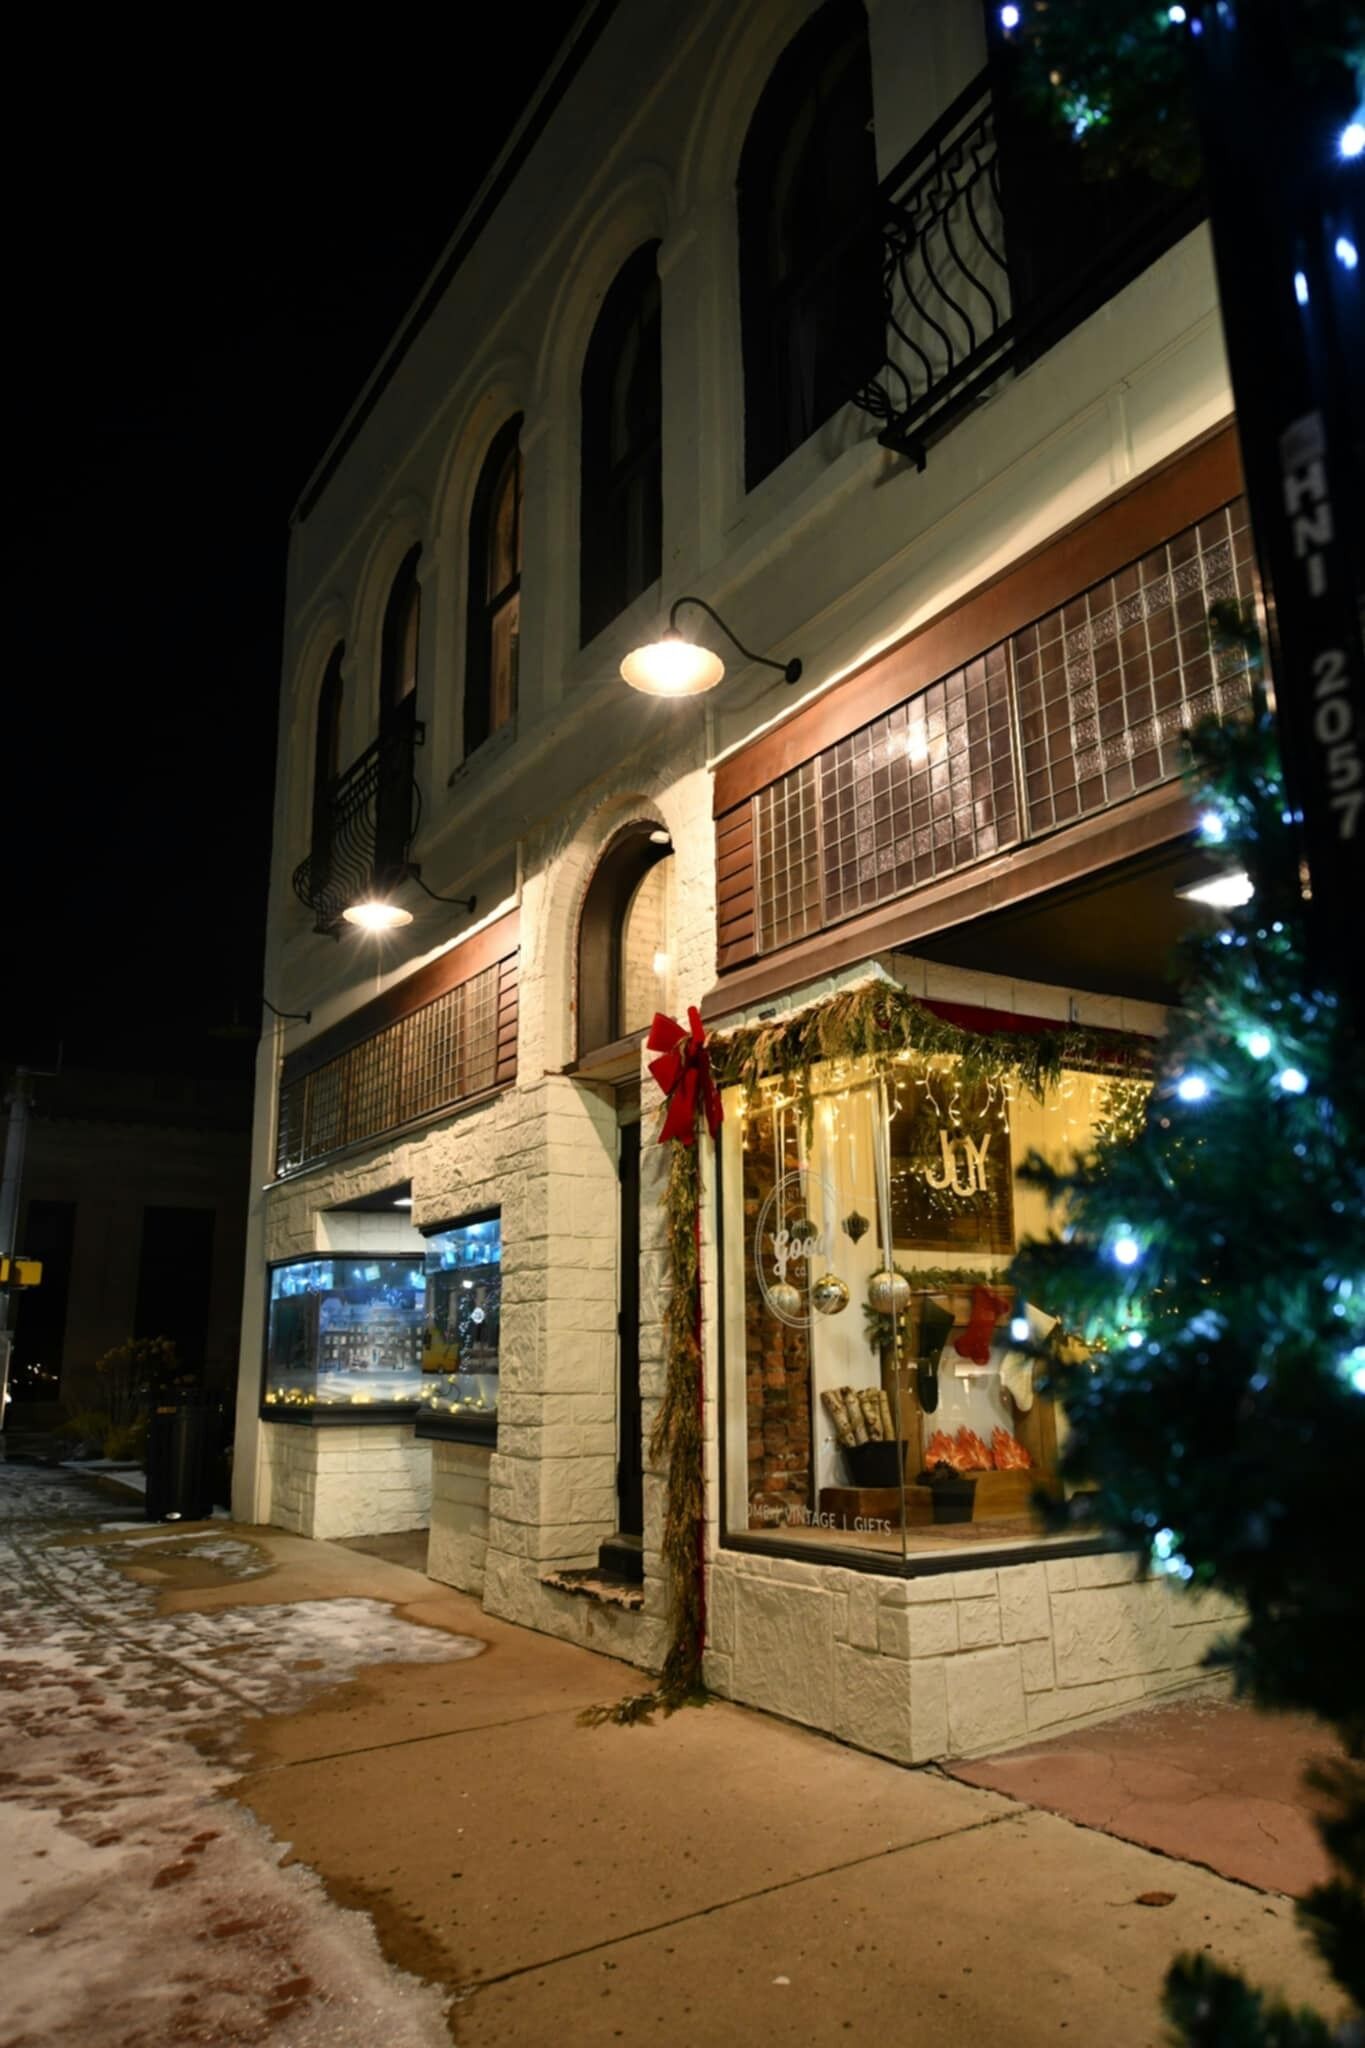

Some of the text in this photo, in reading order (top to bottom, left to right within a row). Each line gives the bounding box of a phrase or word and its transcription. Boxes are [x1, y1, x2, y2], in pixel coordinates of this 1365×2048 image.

[1312, 651, 1363, 839] 2057
[924, 1129, 992, 1197] JOY
[784, 1503, 836, 1529] VINTAGE
[853, 1516, 892, 1536] GIFTS
